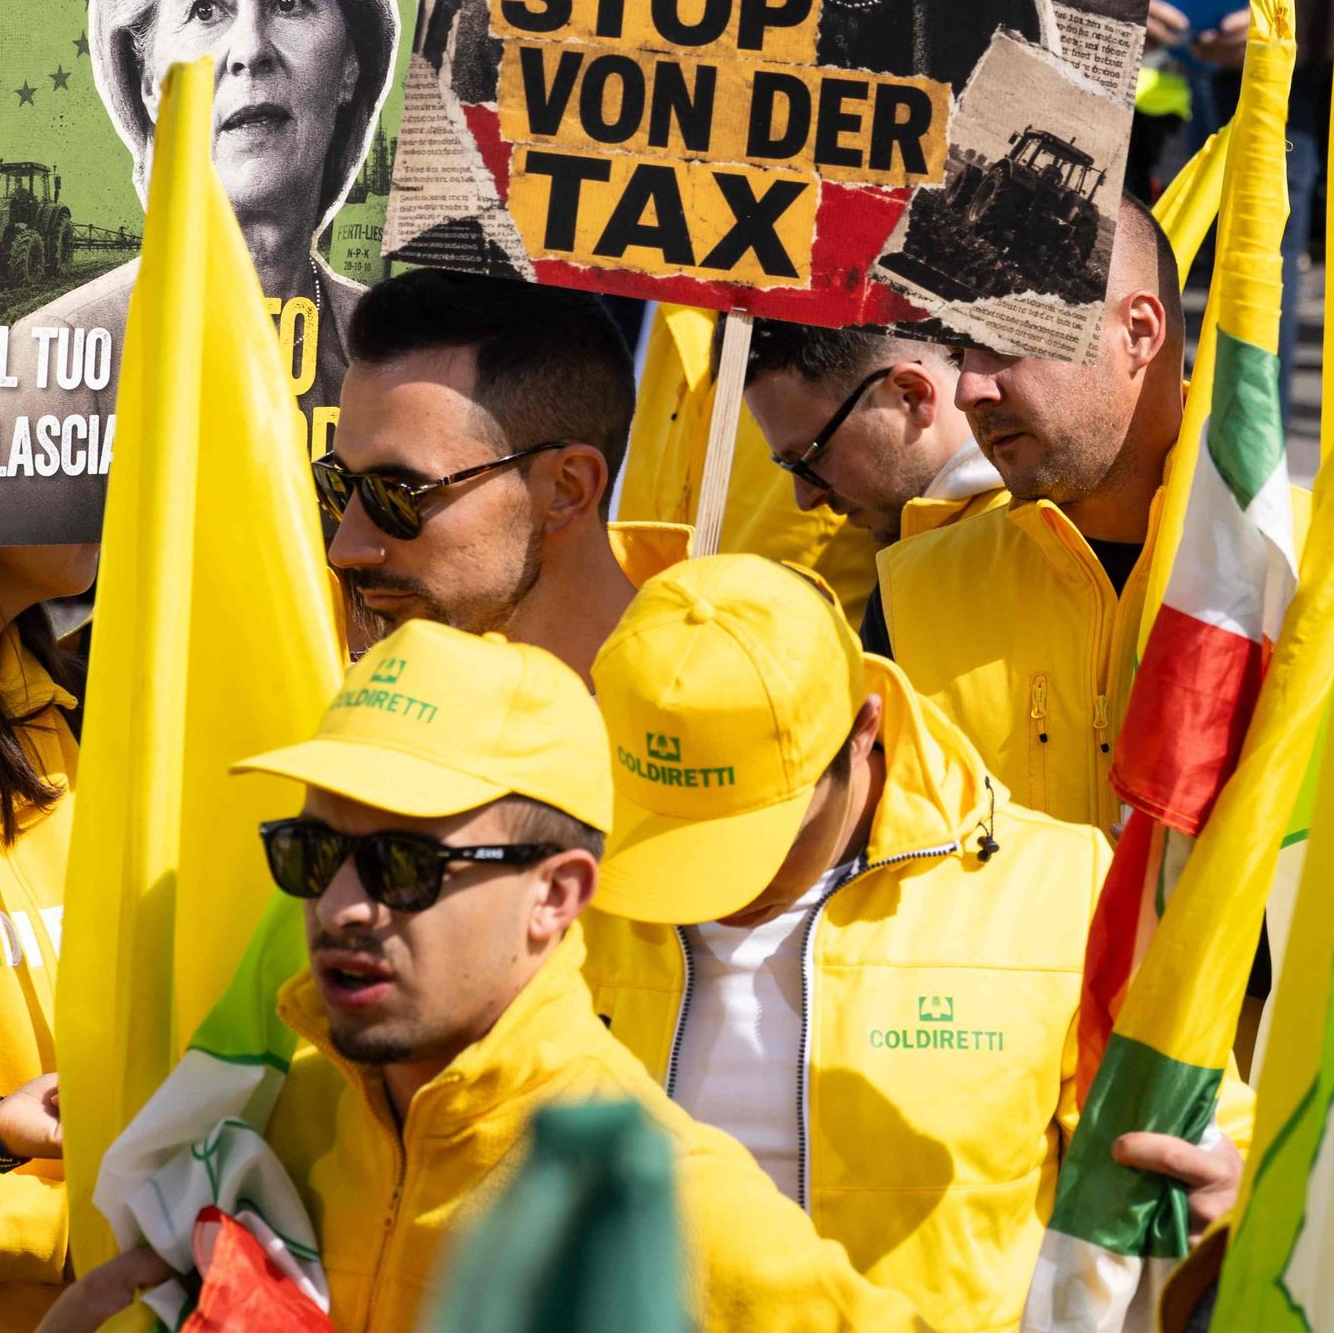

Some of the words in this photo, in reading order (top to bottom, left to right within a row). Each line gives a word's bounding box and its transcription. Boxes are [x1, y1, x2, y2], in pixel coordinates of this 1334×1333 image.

[520, 47, 716, 152] VON
[745, 70, 932, 176] DER
[337, 223, 383, 243] FERTI-LIES
[524, 151, 810, 279] TAX
[31, 326, 113, 391] TUO
[617, 745, 735, 788] COLDIRETTI
[870, 1029, 1004, 1051] COLDIRETTI
